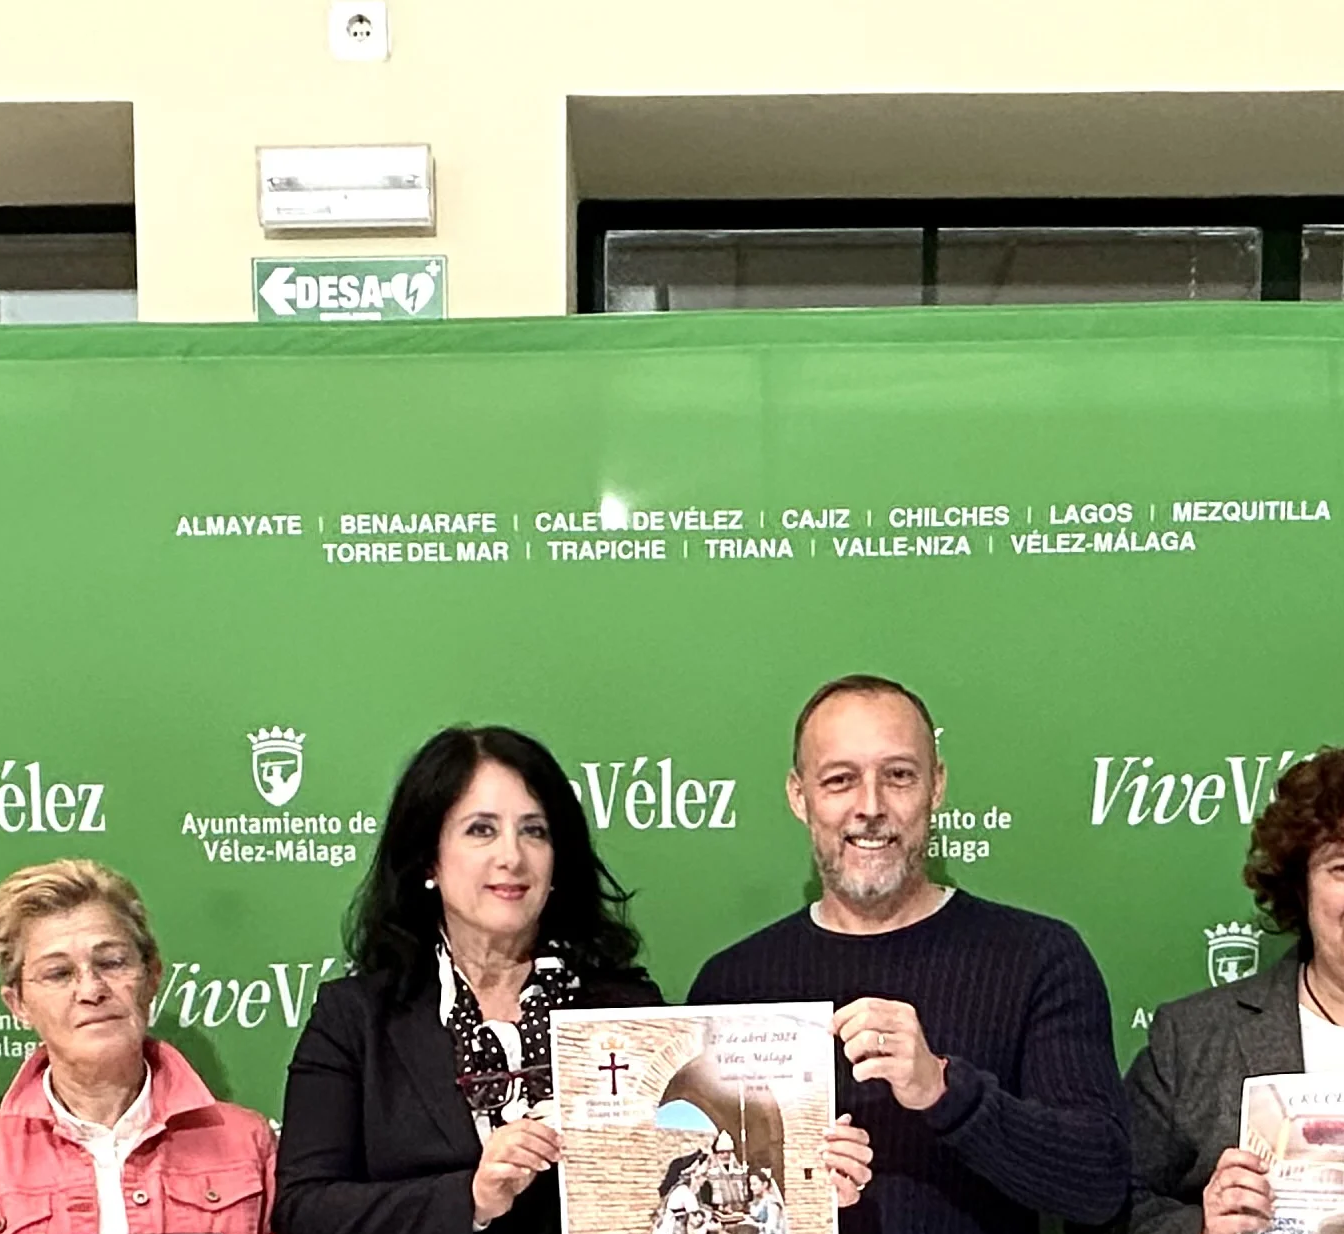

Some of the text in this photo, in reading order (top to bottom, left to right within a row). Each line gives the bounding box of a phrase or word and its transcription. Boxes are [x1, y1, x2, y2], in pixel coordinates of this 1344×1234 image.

[295, 274, 384, 309] DESA
[175, 500, 1331, 537] ALMAYATE BENAJARAFE CALE DE VÉLEZ CAJIZ CHILCHES LAGOS MEZQUITILLA
[322, 529, 1196, 563] TORRE DEL MAR TRAPICHE TRIANA VALLE-NIZA VÉLEZ-MÁLAGA
[570, 756, 736, 830] Vélez
[181, 810, 377, 840] Ayuntamiento de
[983, 805, 1012, 829] de
[203, 838, 357, 867] Vélez-Málaga
